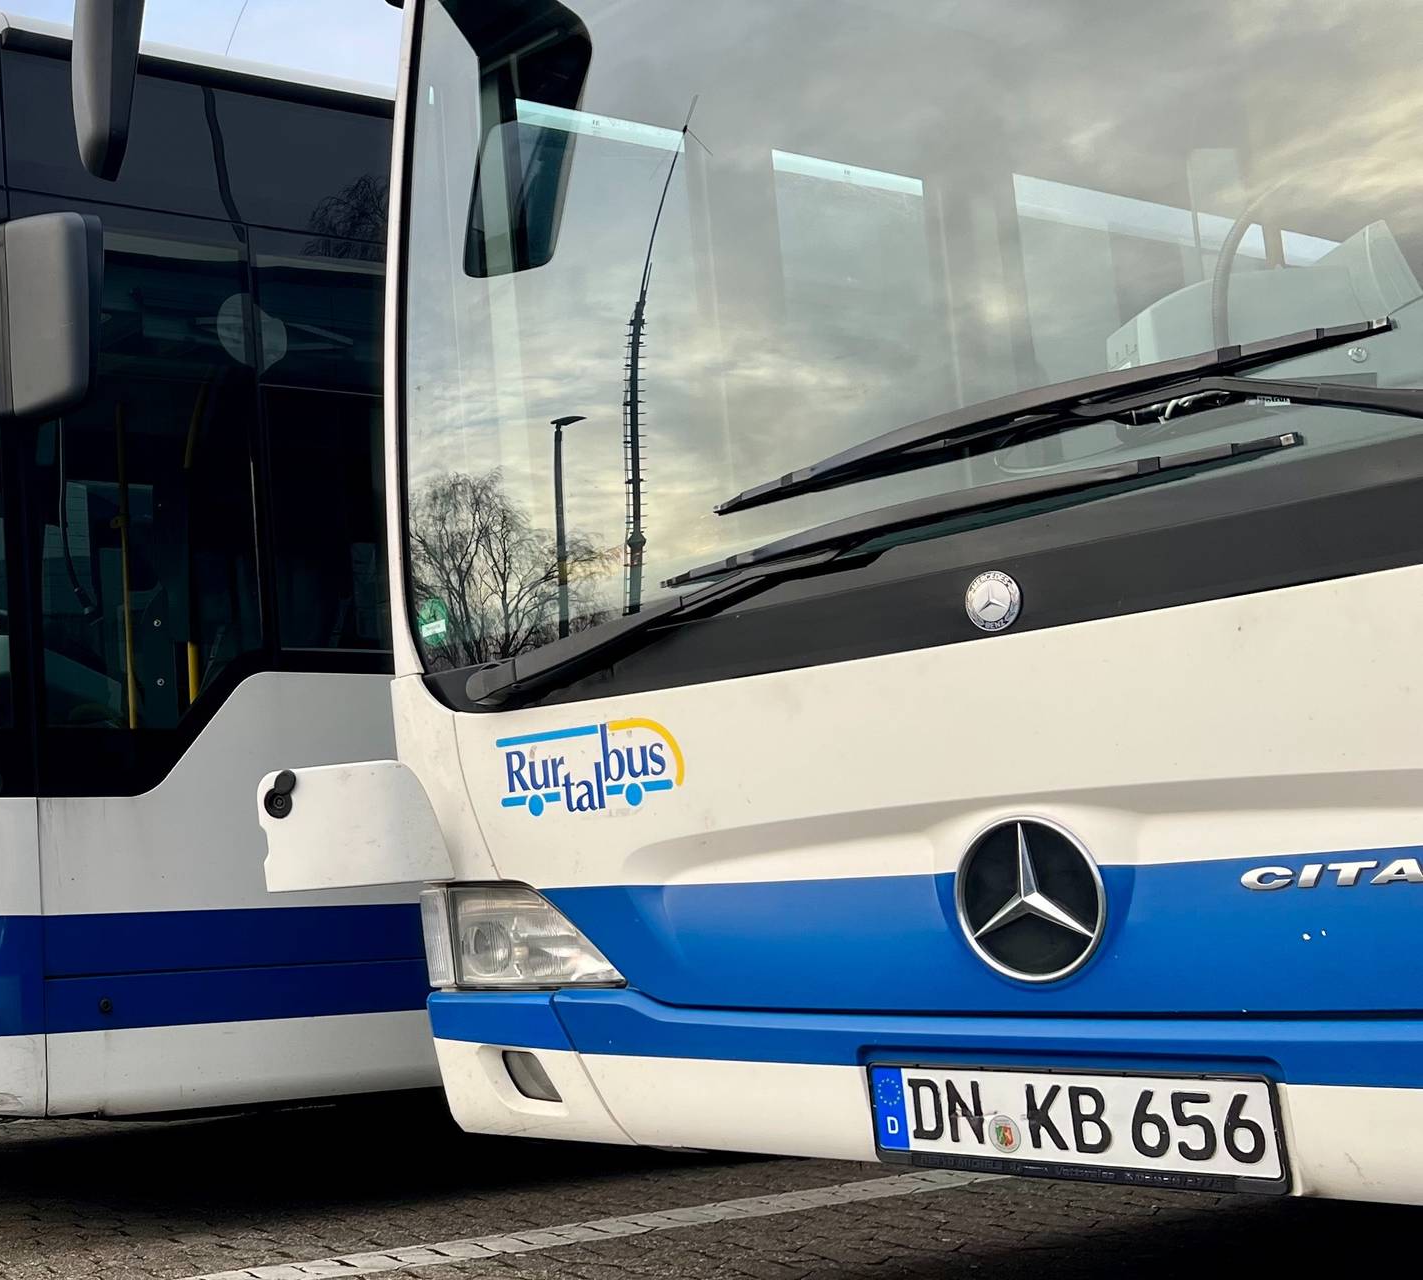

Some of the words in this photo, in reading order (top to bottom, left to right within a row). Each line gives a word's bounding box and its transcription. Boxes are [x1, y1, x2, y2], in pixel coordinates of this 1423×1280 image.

[1240, 858, 1423, 890] CITA
[886, 1116, 900, 1134] D
[907, 1078, 985, 1145] DN
[1025, 1083, 1113, 1154] KB
[1131, 1089, 1266, 1164] 656
